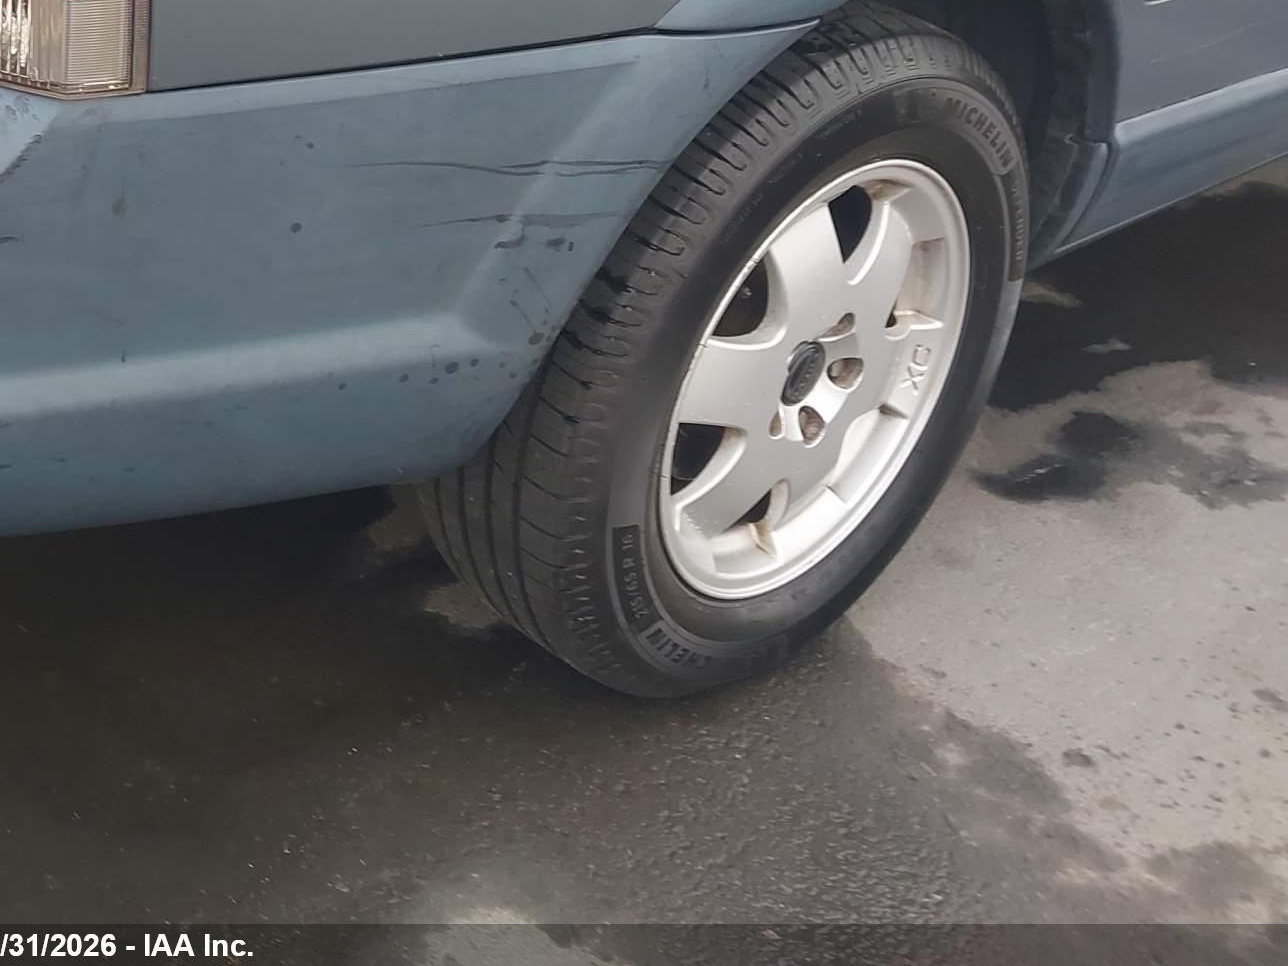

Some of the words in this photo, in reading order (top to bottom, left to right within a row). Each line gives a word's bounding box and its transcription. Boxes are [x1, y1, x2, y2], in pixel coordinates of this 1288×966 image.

[938, 96, 1014, 169] MICHELIN
[901, 344, 932, 396] XC
[623, 572, 649, 619] 215/65
